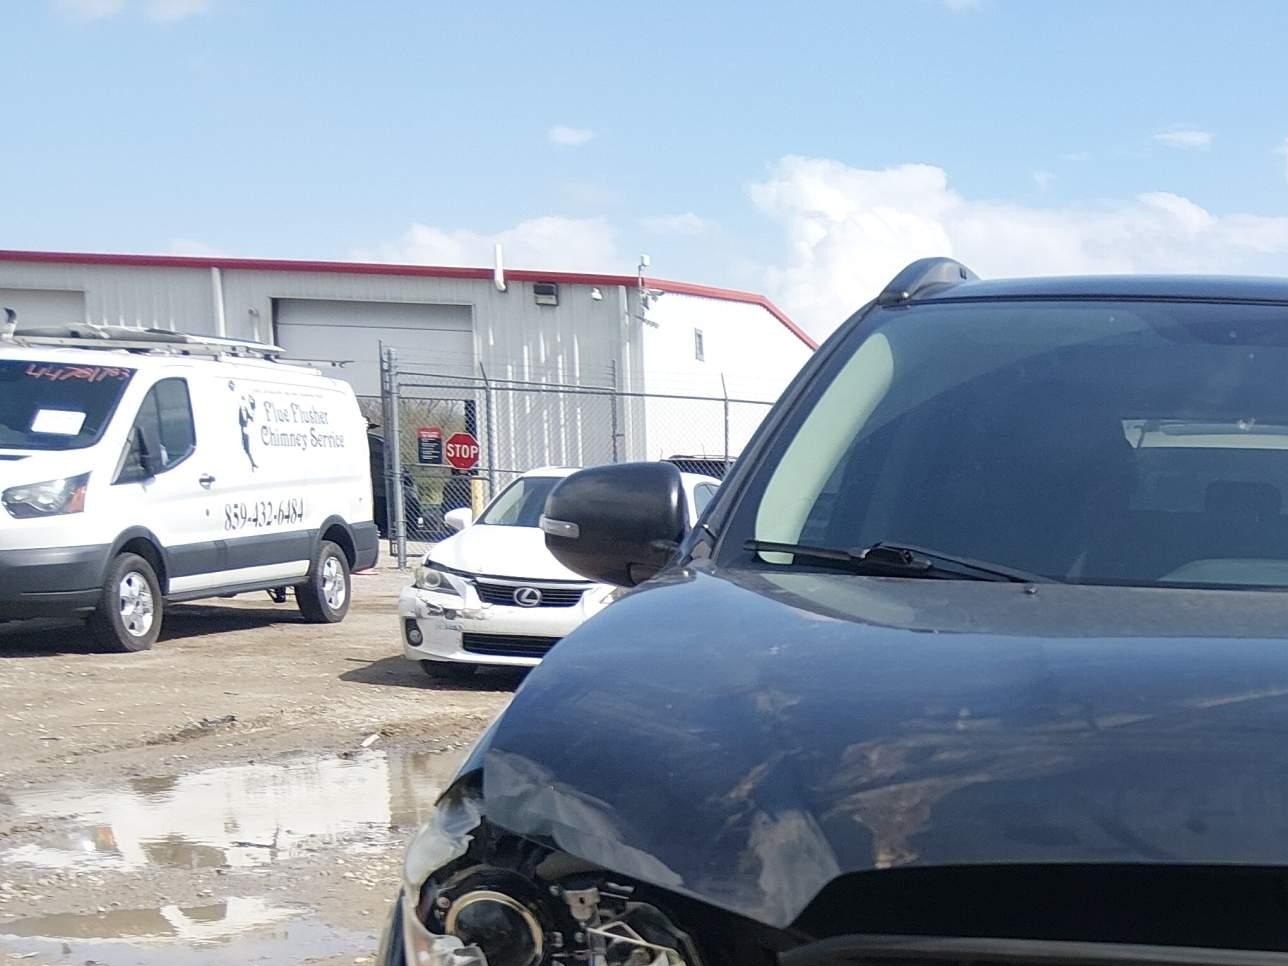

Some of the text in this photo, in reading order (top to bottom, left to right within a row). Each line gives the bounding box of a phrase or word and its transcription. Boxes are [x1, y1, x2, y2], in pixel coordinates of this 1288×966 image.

[290, 402, 329, 425] Flusher
[260, 425, 345, 451] Chimney Service
[446, 443, 479, 459] STOP
[224, 496, 304, 531] 859-432-6484
